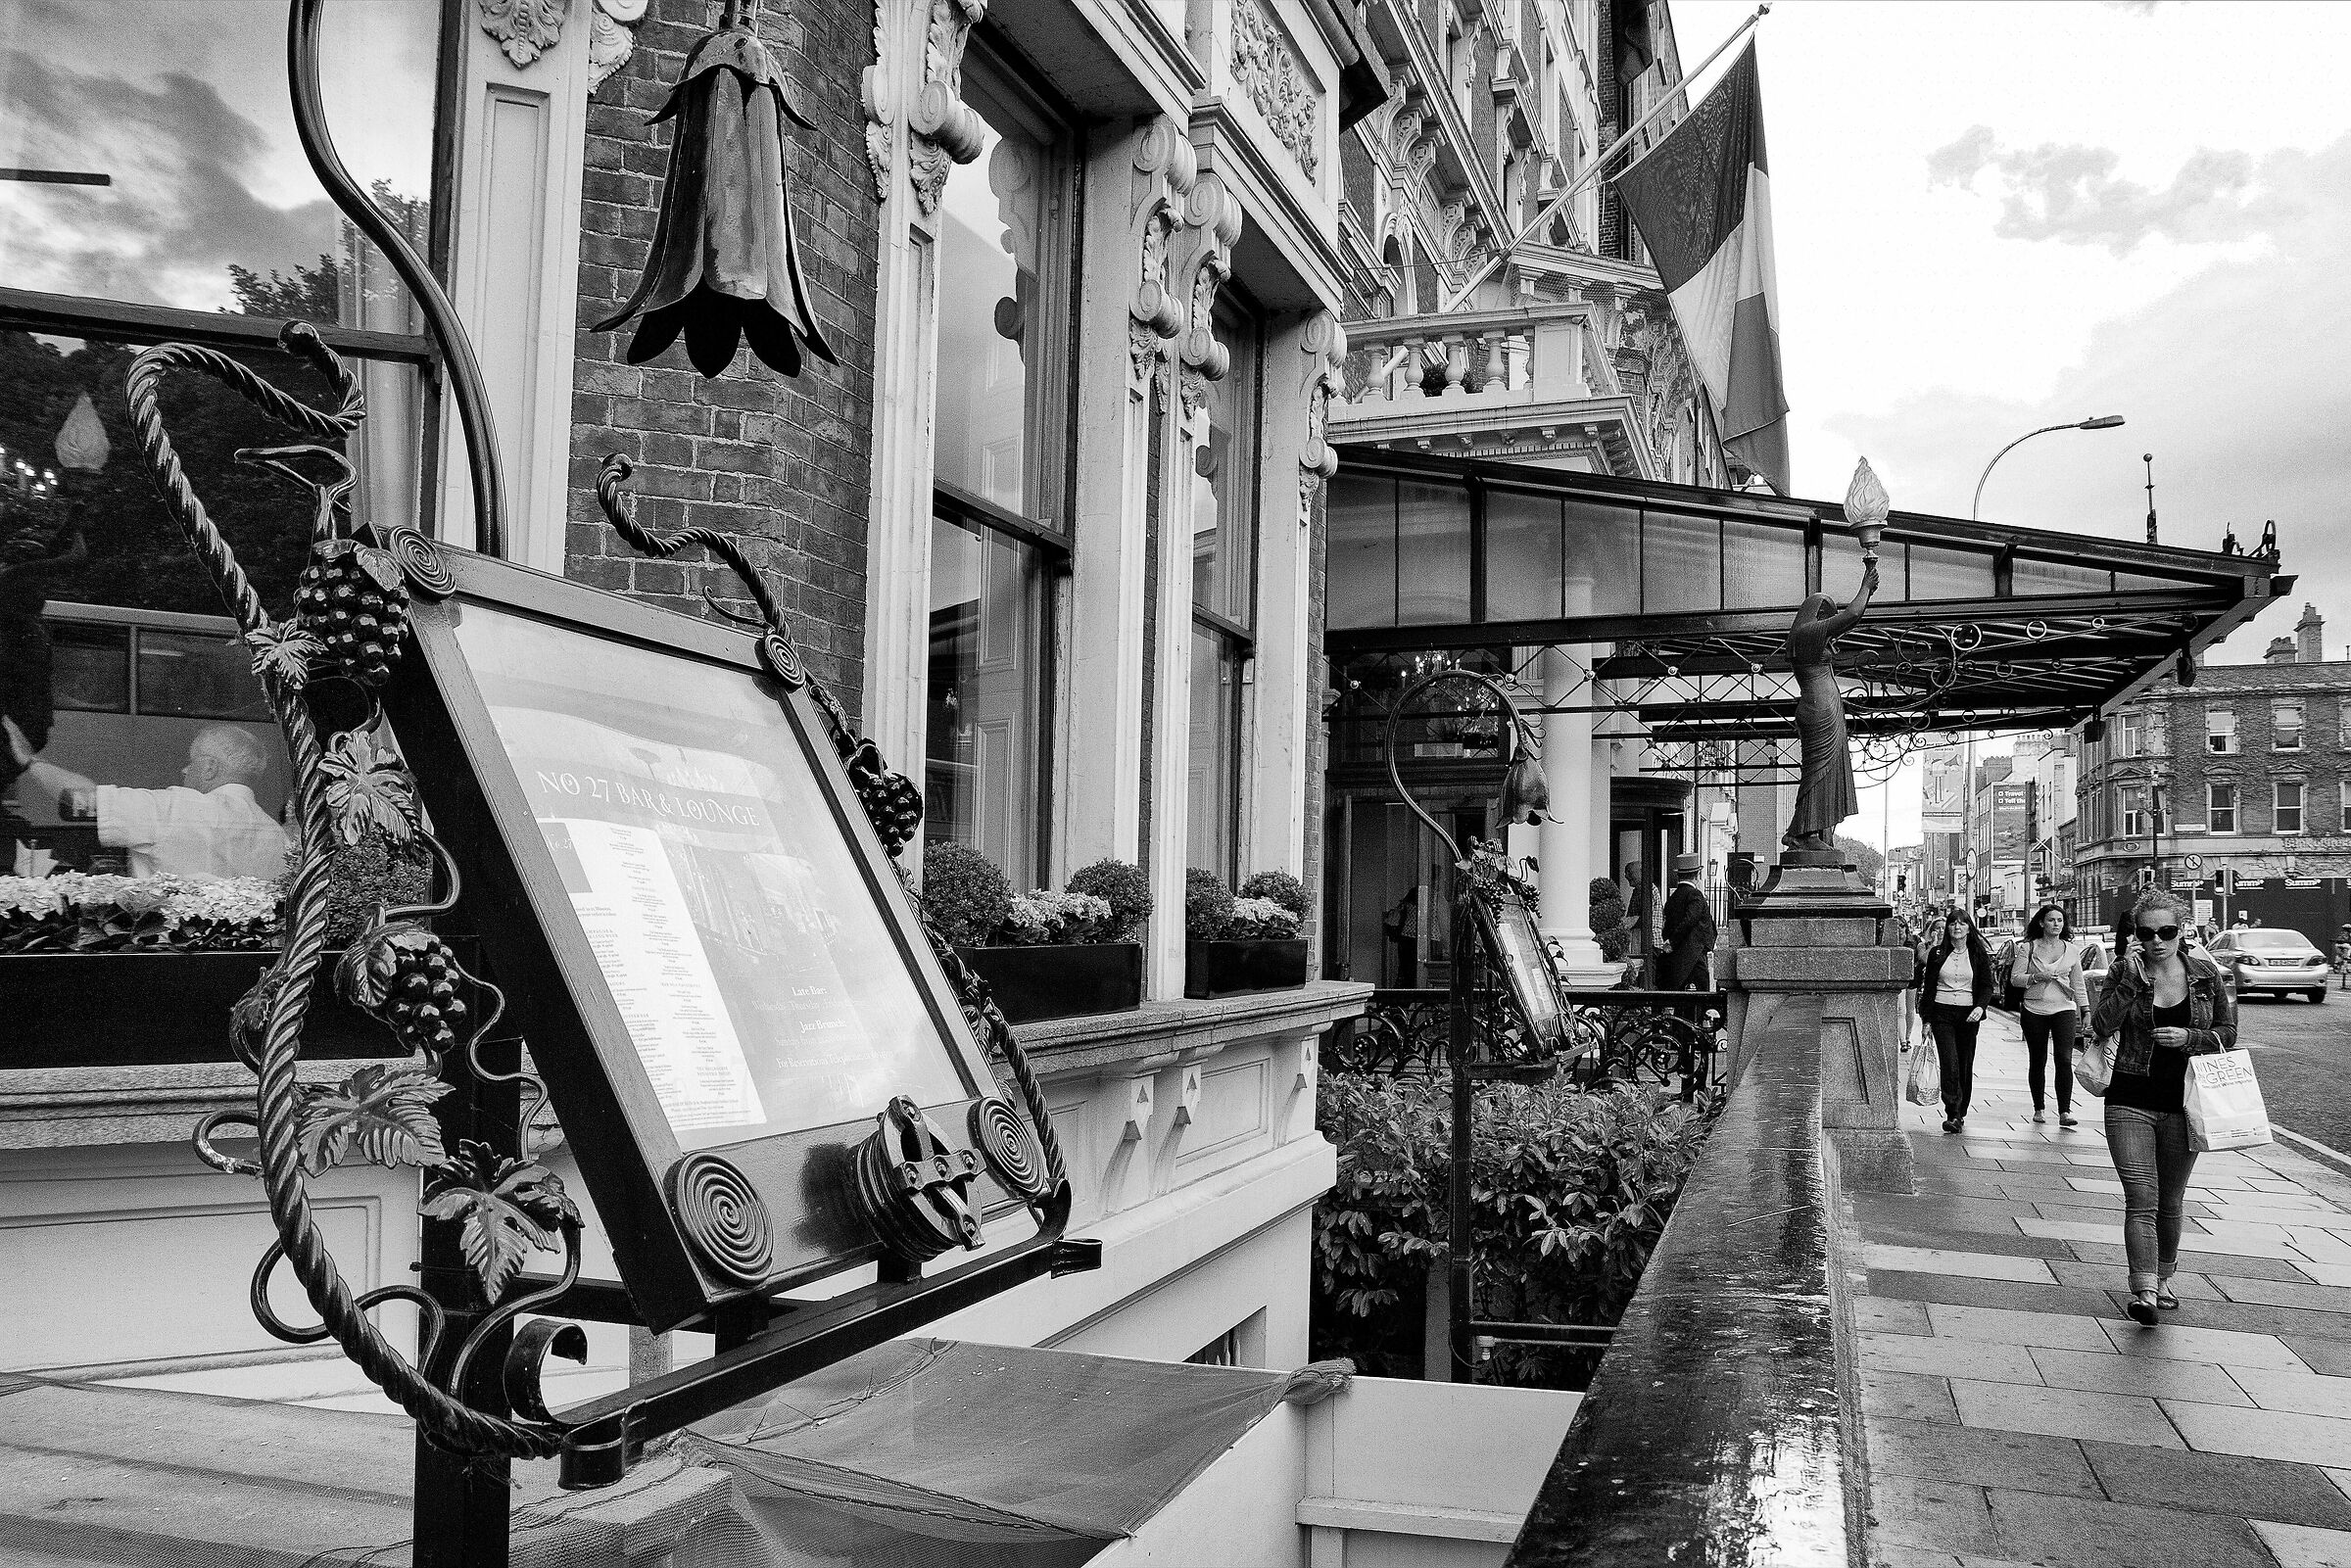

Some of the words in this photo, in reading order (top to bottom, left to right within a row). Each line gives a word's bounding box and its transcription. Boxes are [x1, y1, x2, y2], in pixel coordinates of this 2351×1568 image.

[535, 770, 581, 795] NO
[585, 775, 611, 803] 27
[615, 782, 666, 817] BAR
[657, 792, 675, 816] &
[674, 797, 760, 827] LOUNGE
[792, 986, 809, 997] Late
[799, 1021, 816, 1034] Jazz
[2206, 1066, 2253, 1084] GREEN
